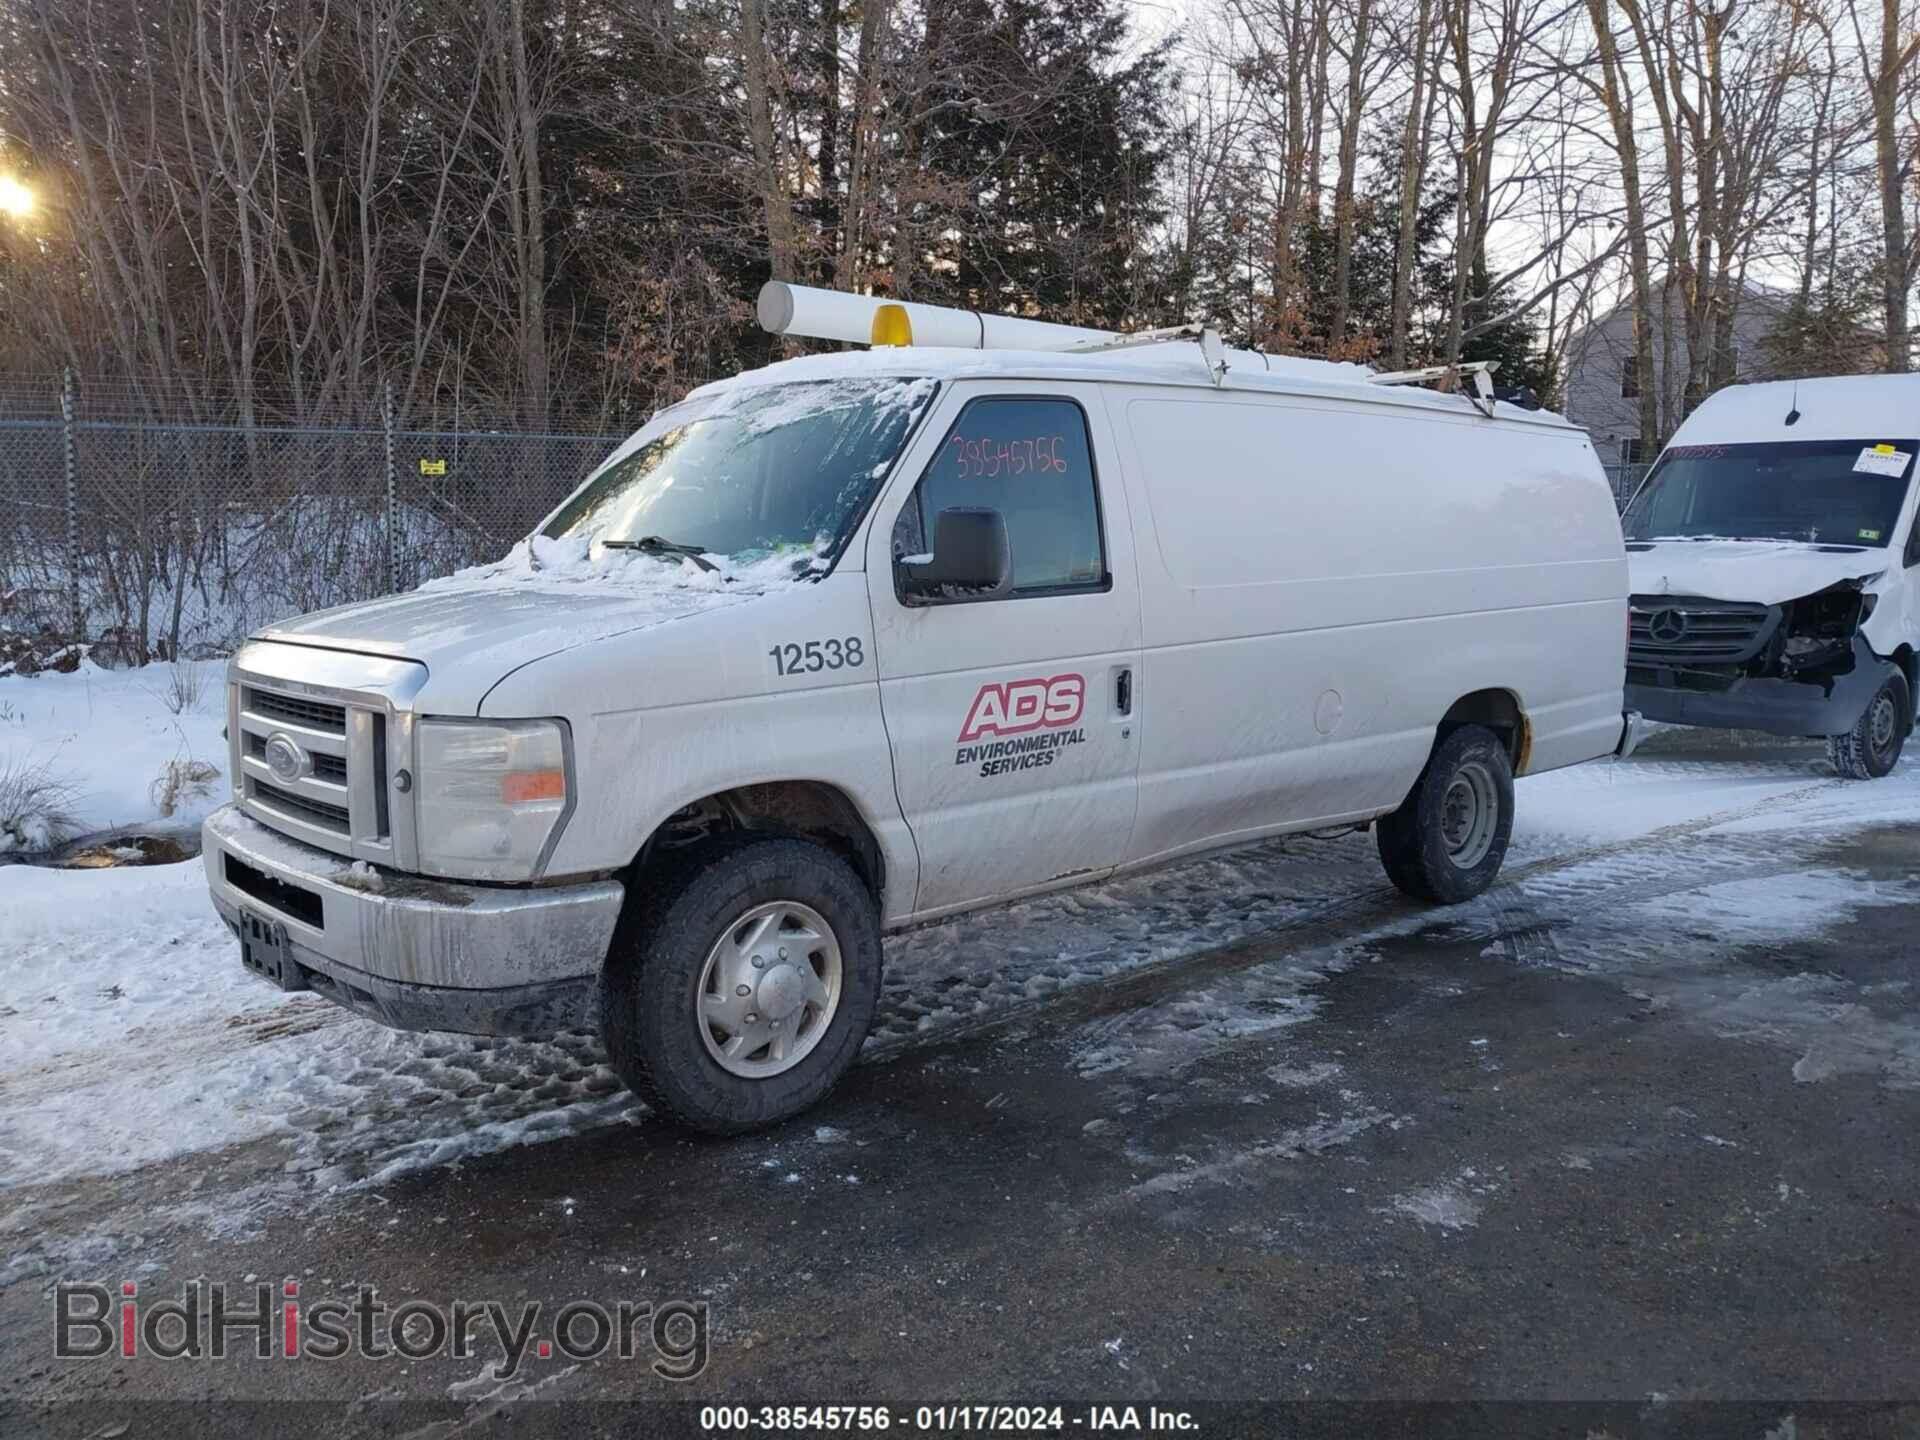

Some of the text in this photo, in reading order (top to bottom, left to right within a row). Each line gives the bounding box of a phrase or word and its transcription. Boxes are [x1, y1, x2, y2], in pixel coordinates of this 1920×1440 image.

[953, 436, 1068, 478] 38545756
[768, 636, 865, 676] 12538
[957, 672, 1086, 743] ADS
[955, 728, 1086, 765] ENVIRONMENTAL
